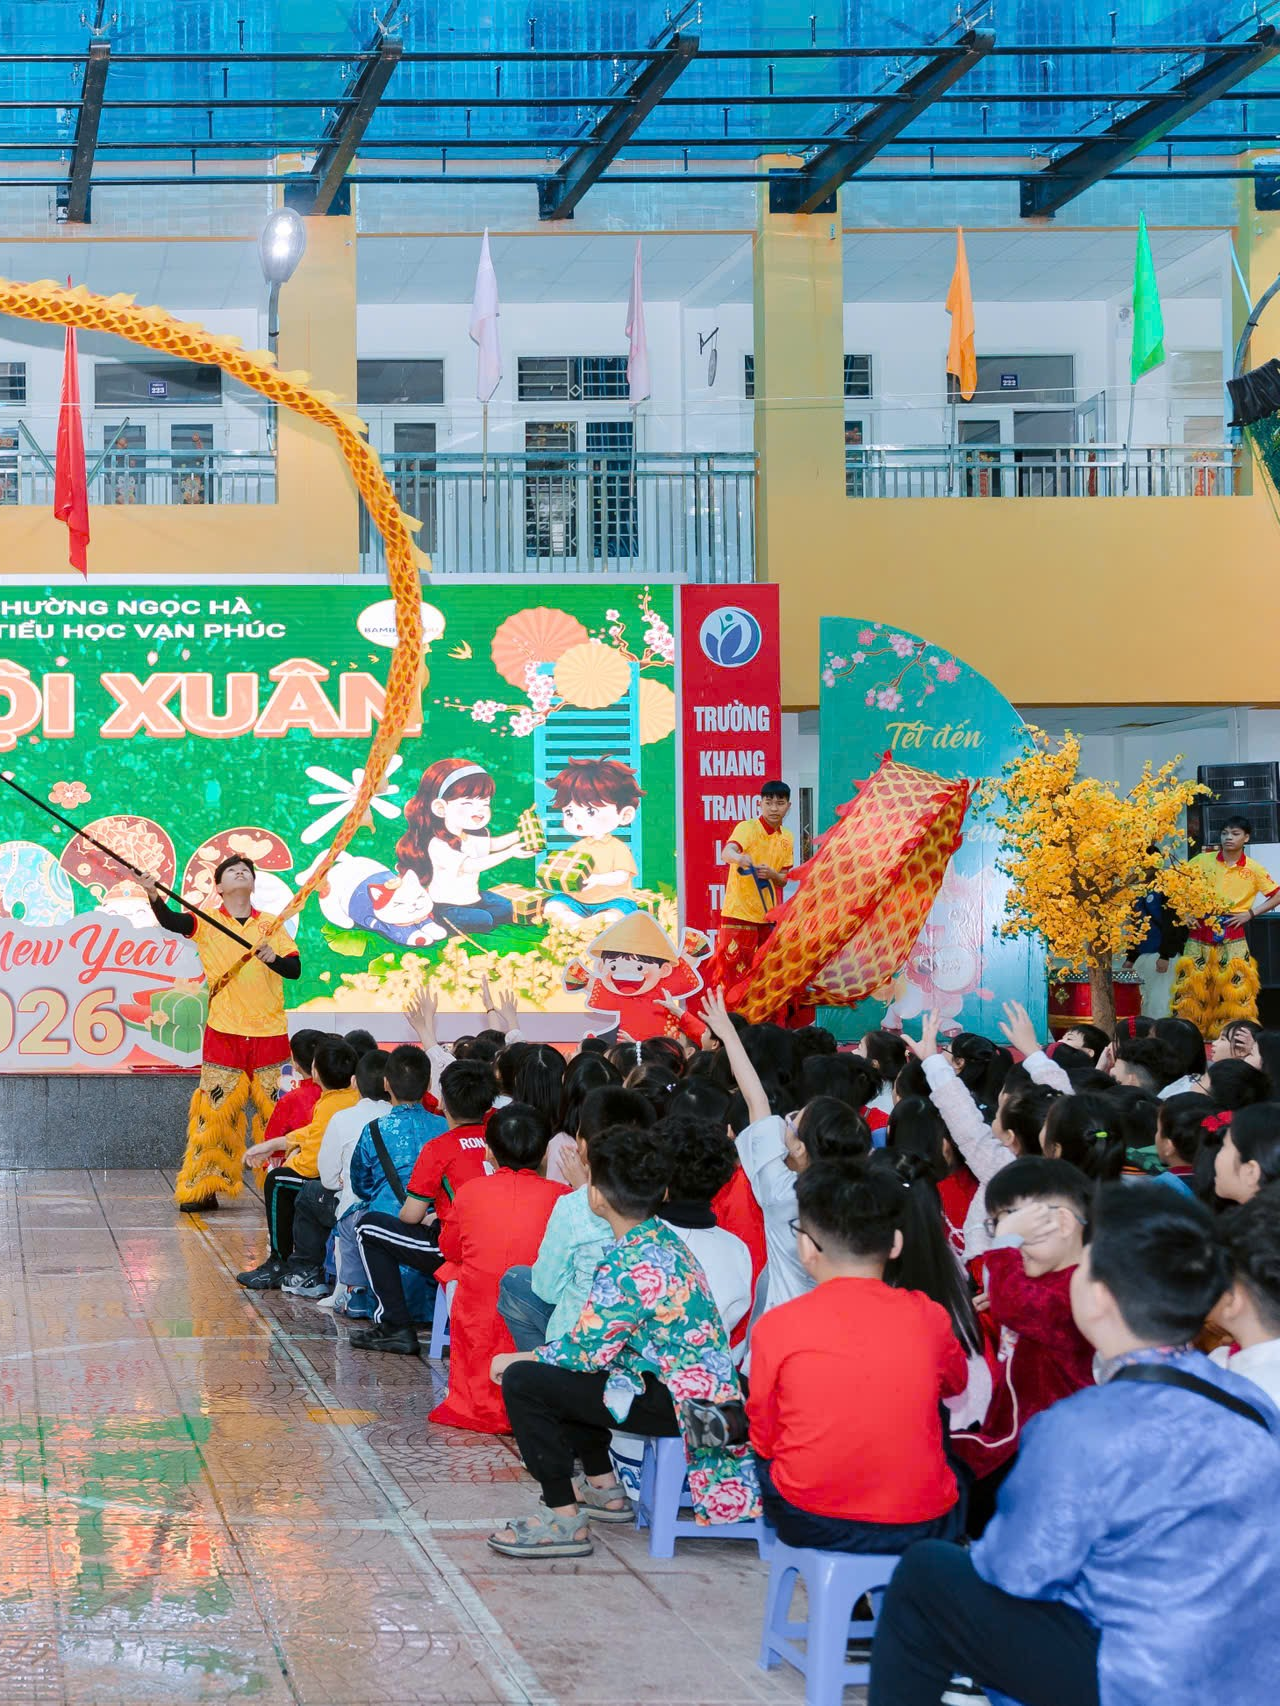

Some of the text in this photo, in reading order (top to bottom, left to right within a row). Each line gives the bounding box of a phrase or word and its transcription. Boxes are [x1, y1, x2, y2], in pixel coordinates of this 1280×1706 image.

[117, 600, 201, 618] NGỌC
[209, 596, 252, 615] HÀ
[63, 623, 127, 641] HỌC
[133, 623, 195, 641] VẠN
[204, 620, 287, 639] PHÚC
[694, 700, 770, 732] TRƯỜNG
[886, 719, 986, 750] Tết đến
[700, 751, 765, 776] KHANG
[701, 795, 762, 821] TRANG
[69, 924, 205, 984] Year
[459, 1137, 486, 1150] RON
